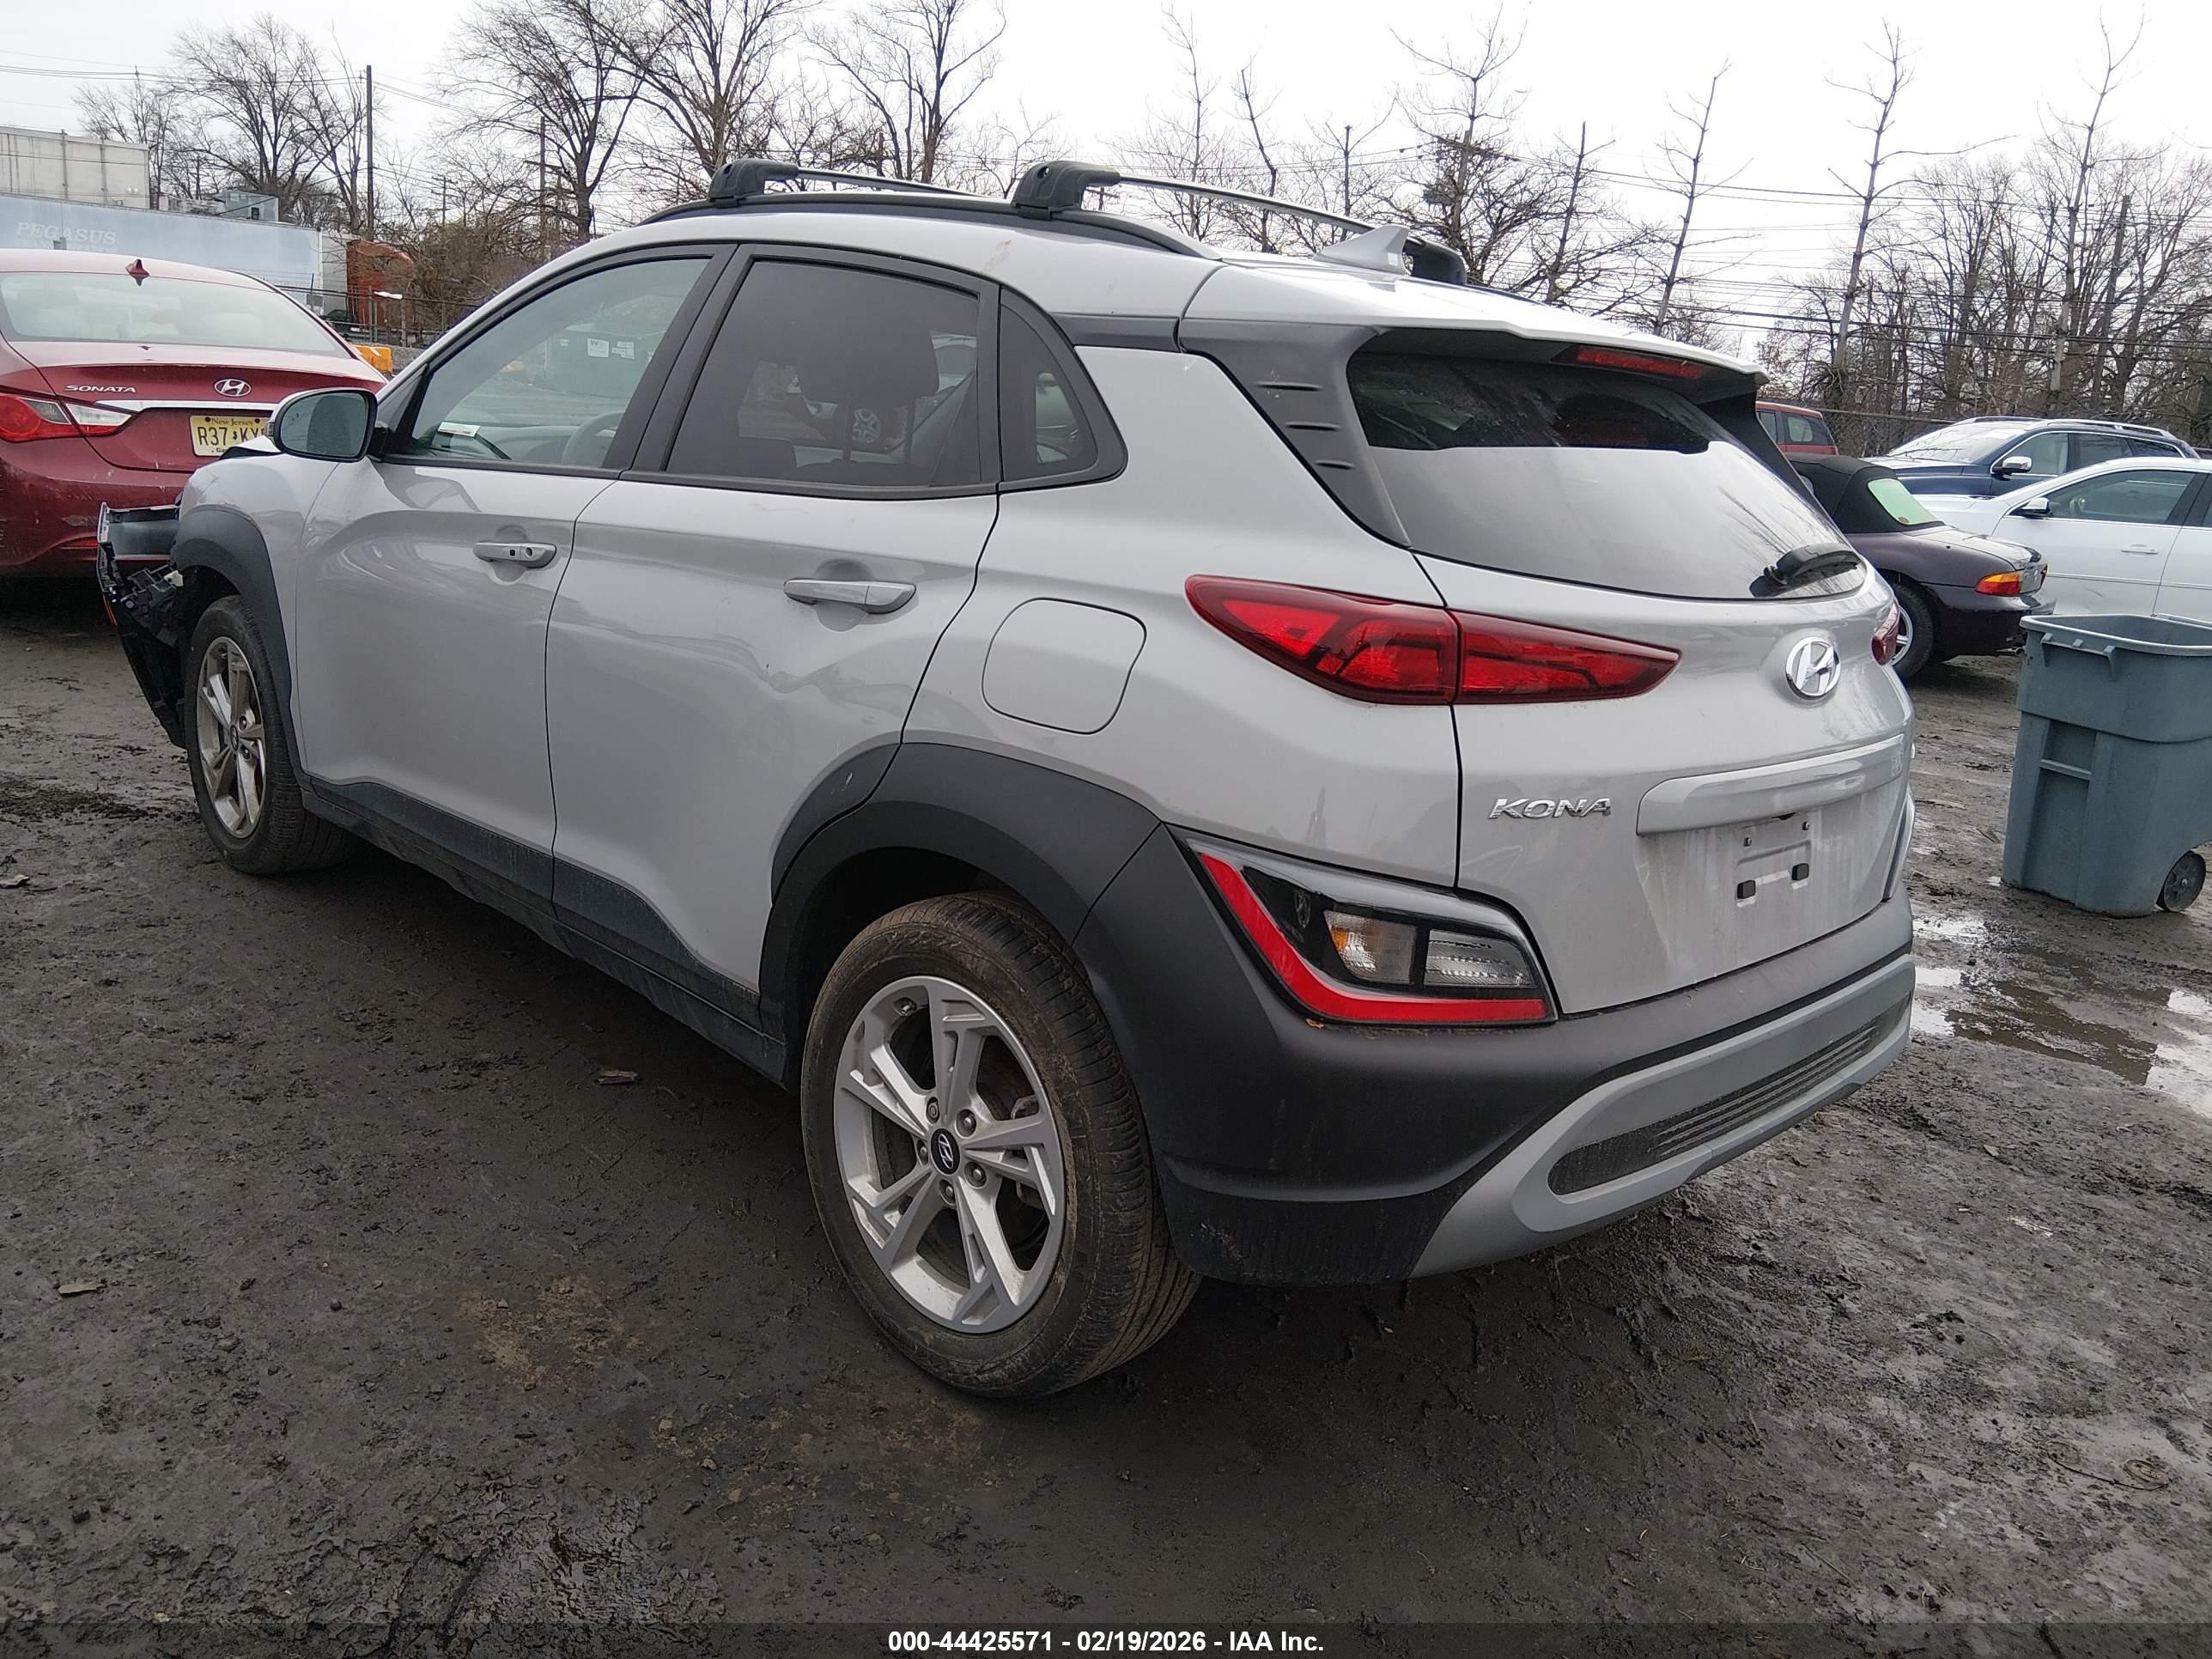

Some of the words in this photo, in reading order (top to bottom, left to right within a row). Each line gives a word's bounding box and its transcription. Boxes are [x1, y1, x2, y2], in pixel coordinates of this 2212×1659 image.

[15, 222, 117, 246] PEGASUS
[64, 385, 137, 393] SONATA
[230, 418, 254, 427] Jersey
[197, 427, 228, 446] R37
[1488, 798, 1612, 819] KONA
